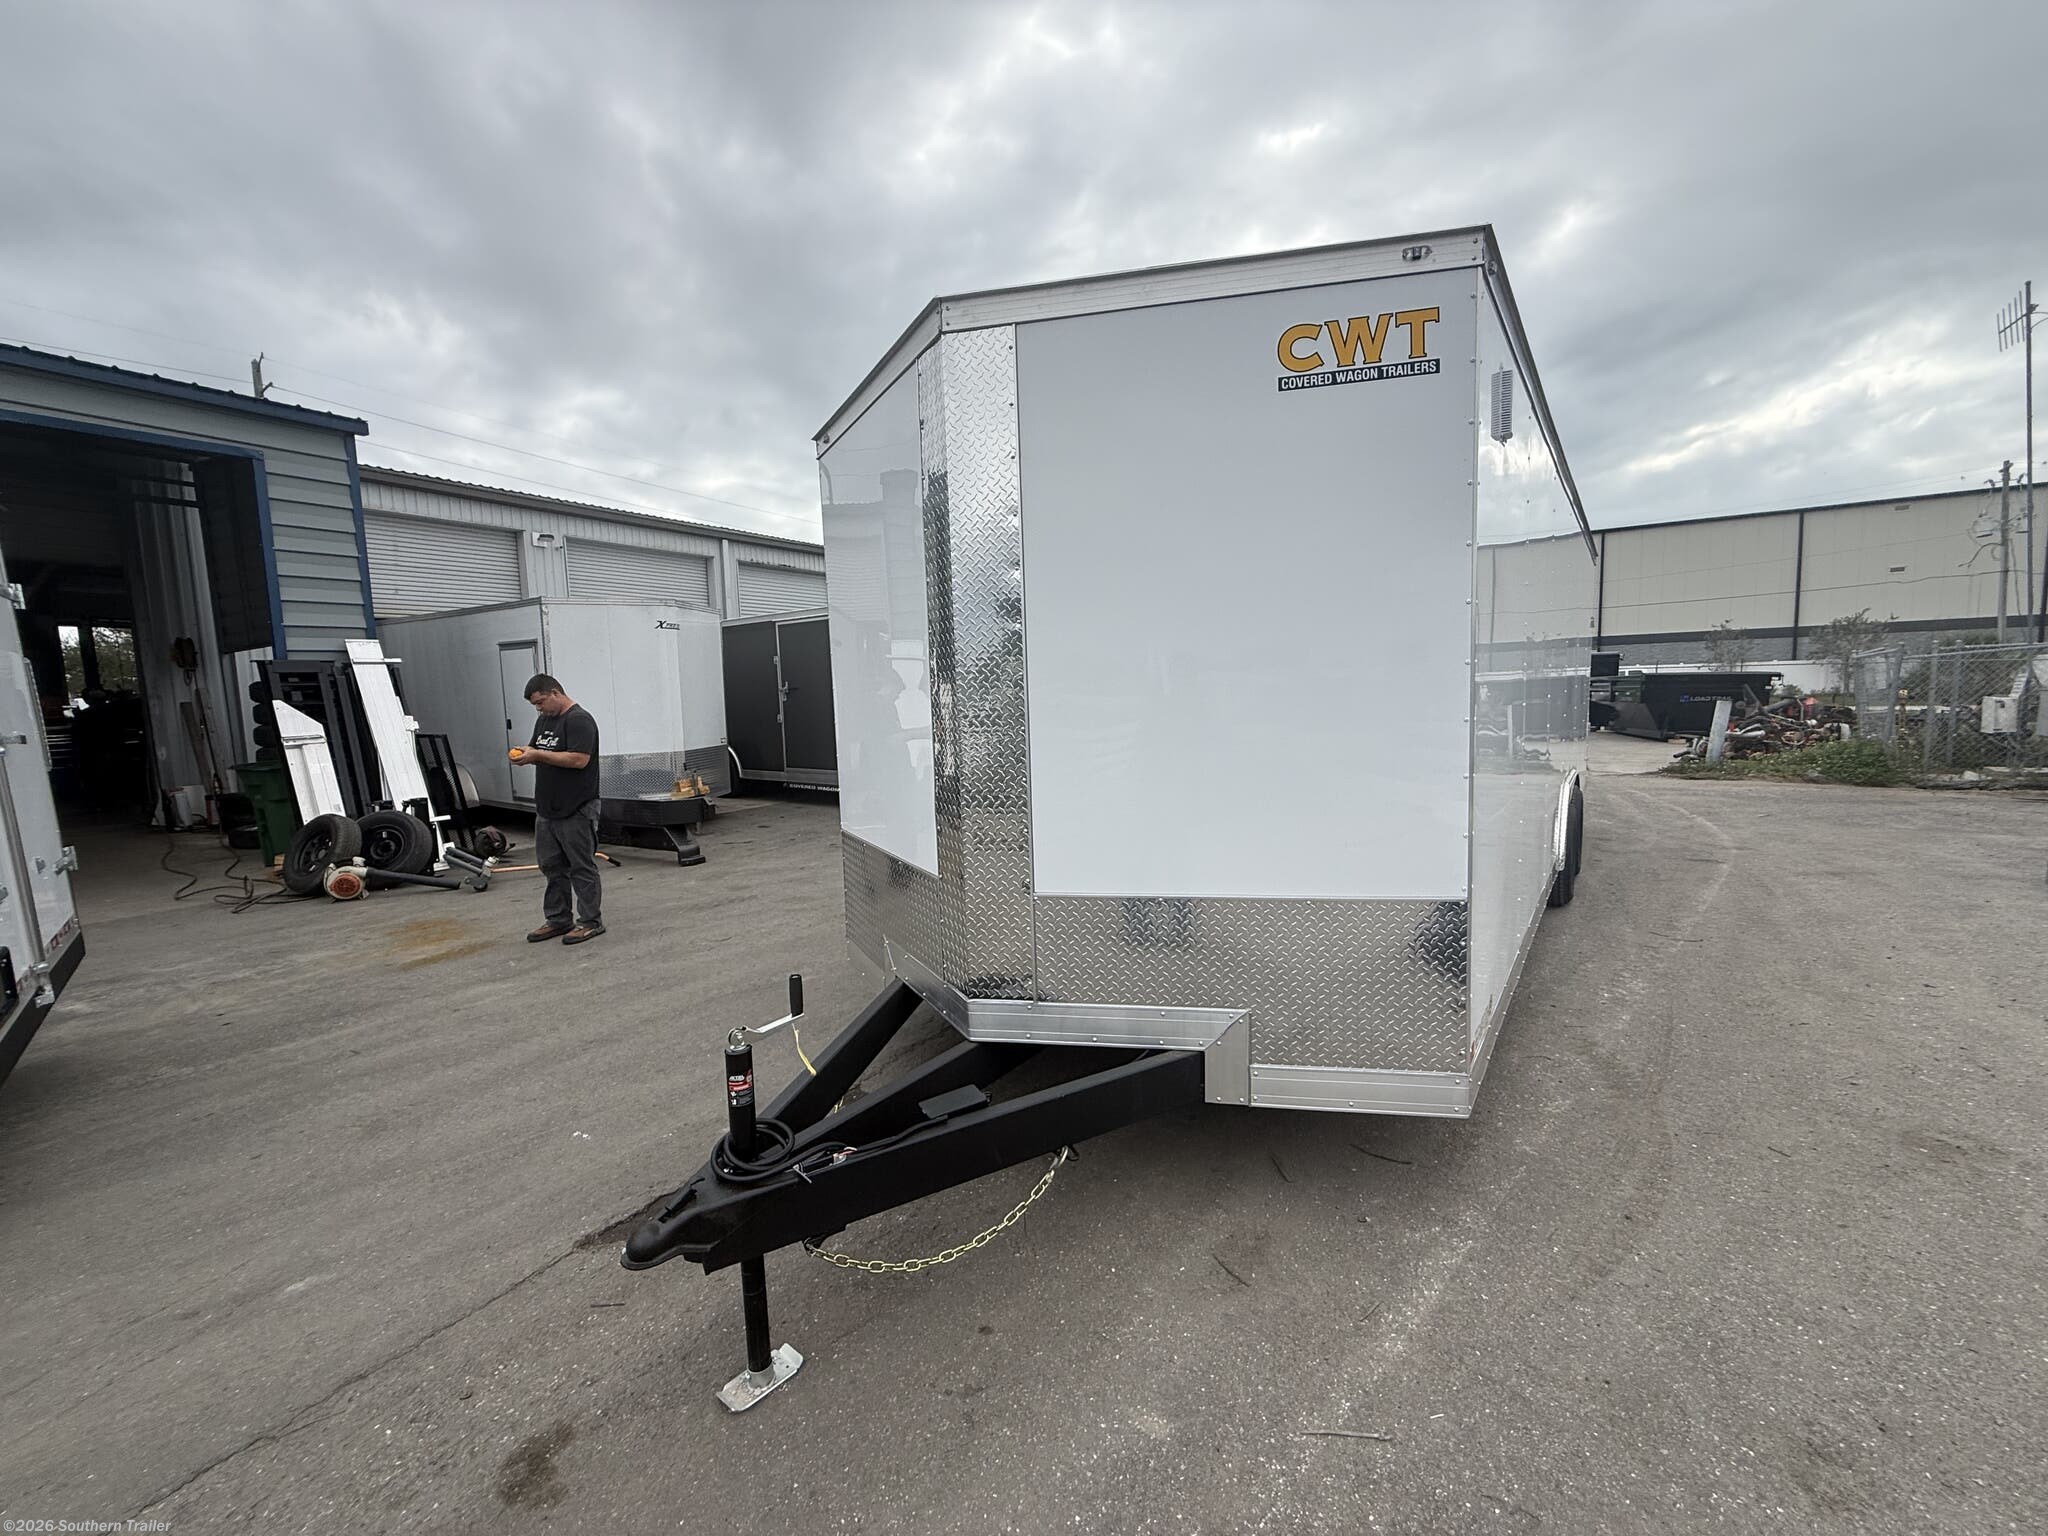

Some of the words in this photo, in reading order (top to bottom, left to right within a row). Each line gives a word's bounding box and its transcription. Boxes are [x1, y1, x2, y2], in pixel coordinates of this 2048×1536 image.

[1277, 306, 1440, 373] CWT
[1281, 373, 1332, 390] COVERED
[1336, 367, 1378, 383] WAGON
[1381, 360, 1437, 377] TRAILERS
